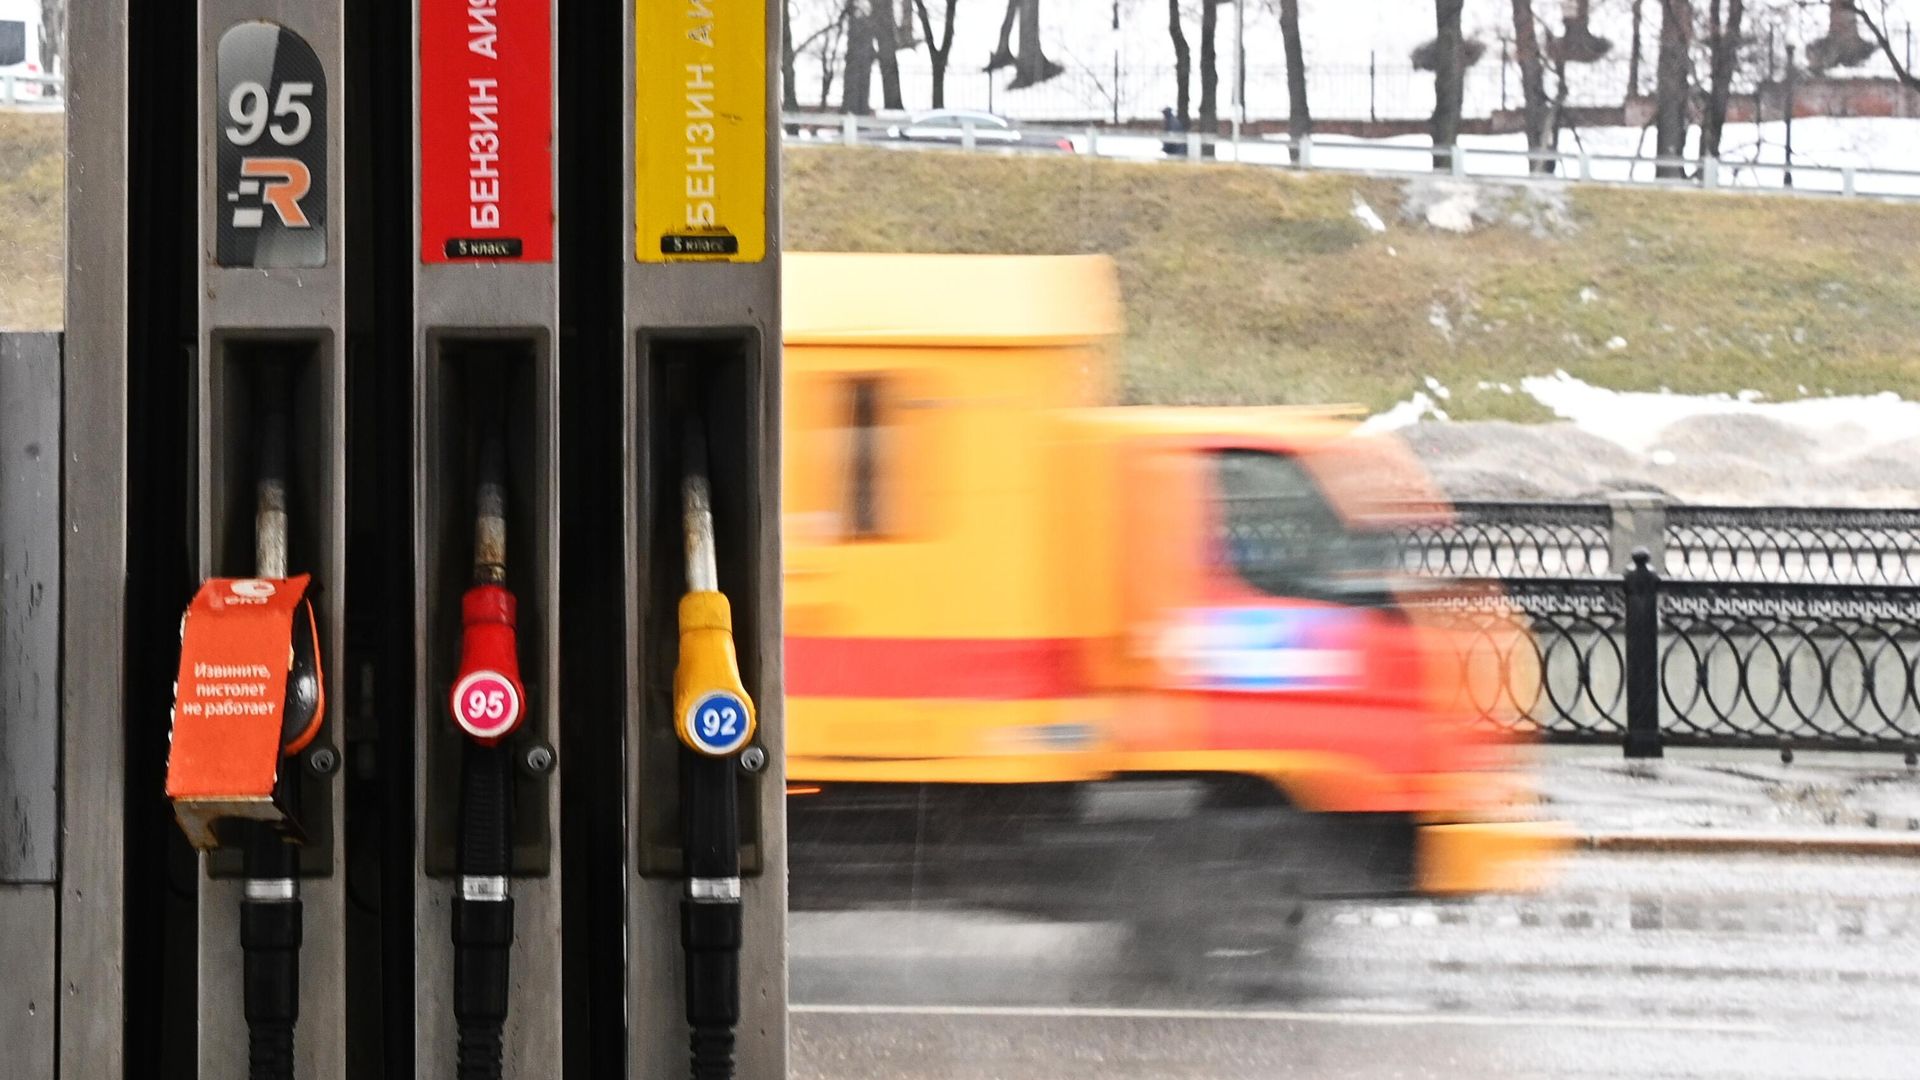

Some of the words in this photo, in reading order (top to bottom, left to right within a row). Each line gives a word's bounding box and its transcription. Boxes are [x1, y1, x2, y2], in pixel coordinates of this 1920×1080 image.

[225, 81, 313, 146] 95
[468, 78, 500, 230] БЕНЗИН
[685, 64, 715, 227] БЕНЗИН
[458, 240, 468, 255] 5
[194, 662, 272, 679] Извините,
[195, 683, 267, 697] пистолет
[467, 689, 505, 719] 95
[182, 701, 202, 716] не
[204, 698, 276, 719] работает
[702, 706, 738, 738] 92
